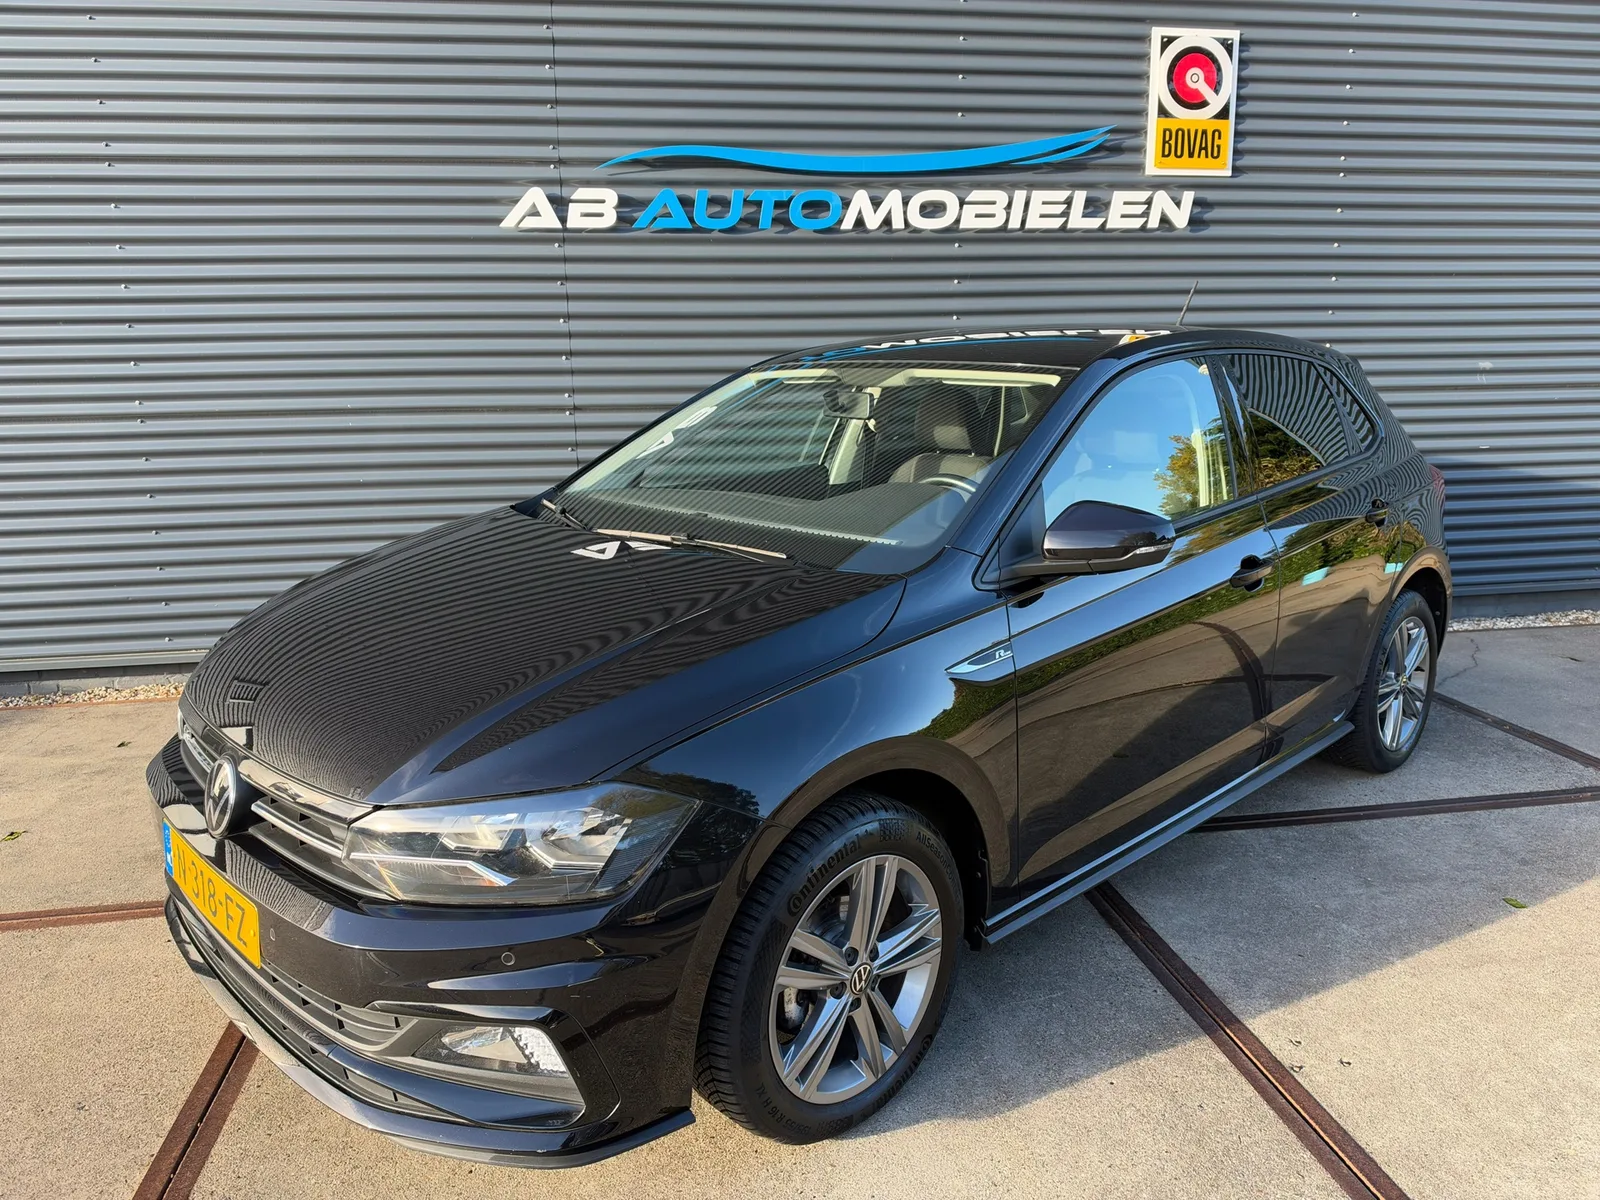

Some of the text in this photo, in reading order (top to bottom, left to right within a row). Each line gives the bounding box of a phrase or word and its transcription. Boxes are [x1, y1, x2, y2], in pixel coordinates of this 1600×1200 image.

[1161, 127, 1222, 160] BOVAG
[499, 186, 1196, 230] AB AUTOMOBIELEN
[176, 843, 248, 948] N-318-FZ
[787, 833, 862, 916] Continental
